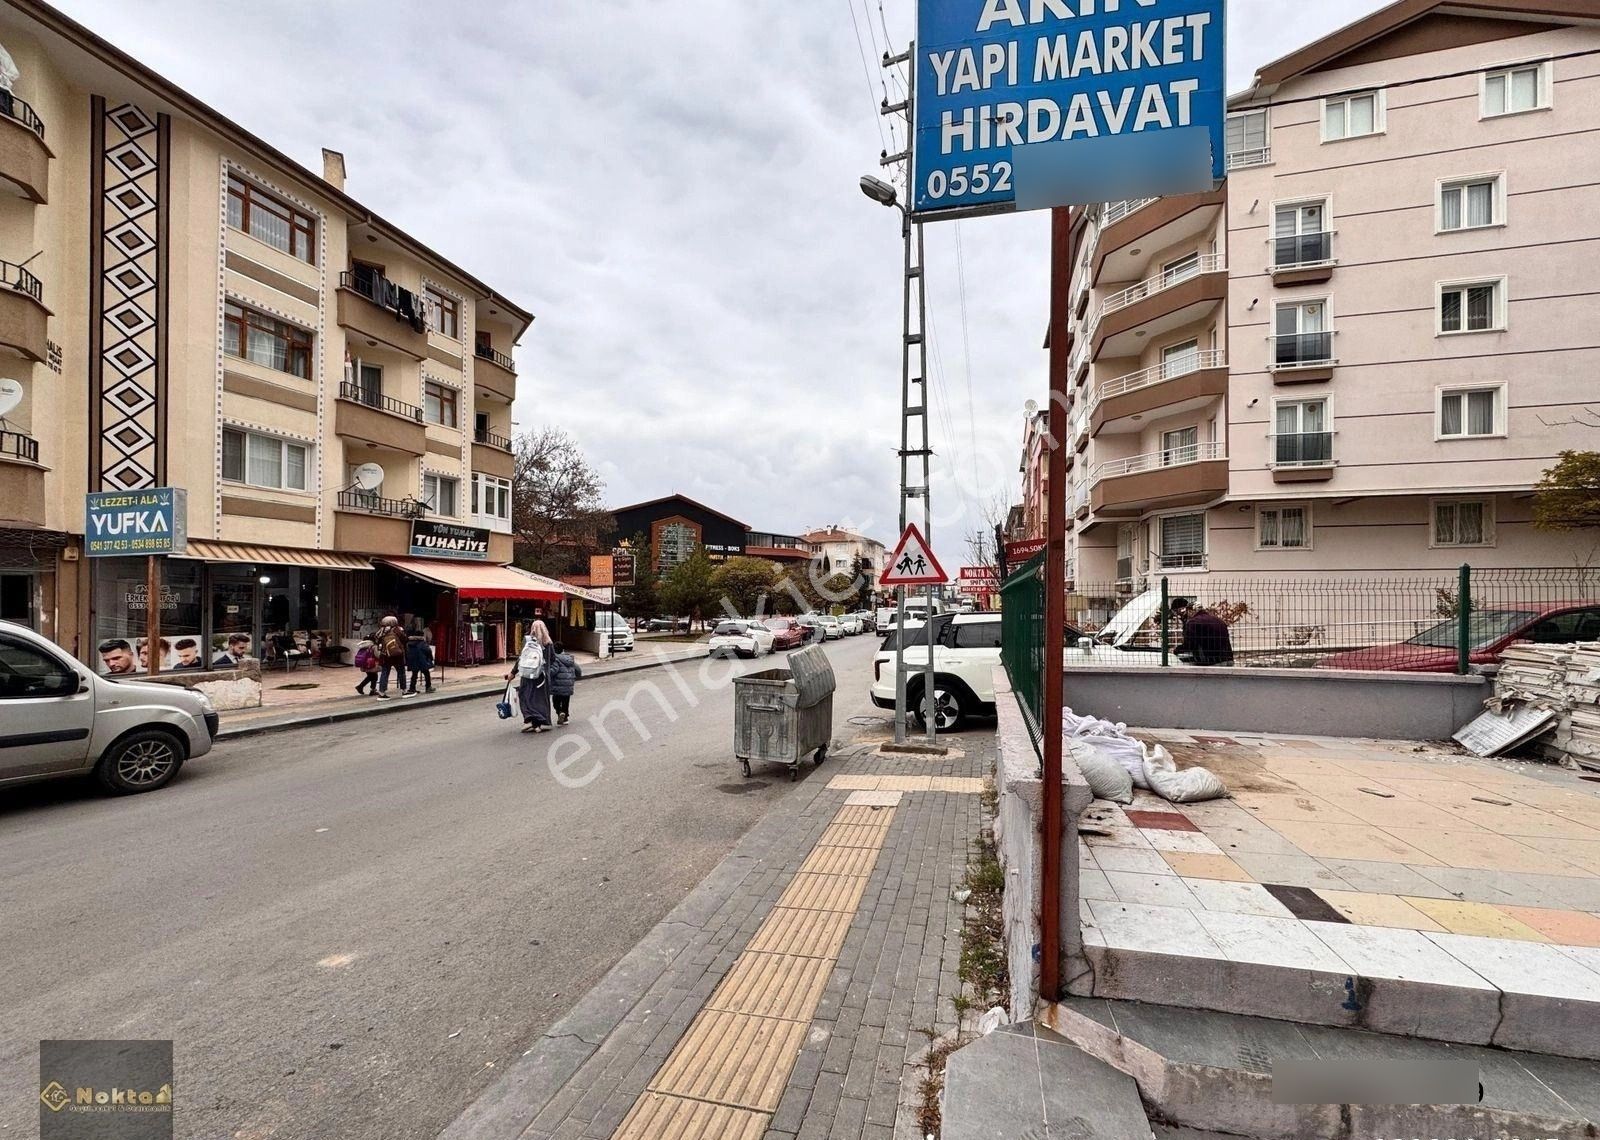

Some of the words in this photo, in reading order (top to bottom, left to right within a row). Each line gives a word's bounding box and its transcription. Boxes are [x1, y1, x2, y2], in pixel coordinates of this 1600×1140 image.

[928, 41, 1019, 96] YAPI
[1032, 12, 1211, 84] MARKET
[941, 78, 1199, 155] HIRDAVAT
[927, 161, 1012, 200] 0552
[91, 510, 168, 535] YUFKA
[415, 534, 487, 552] TUHAFİYE
